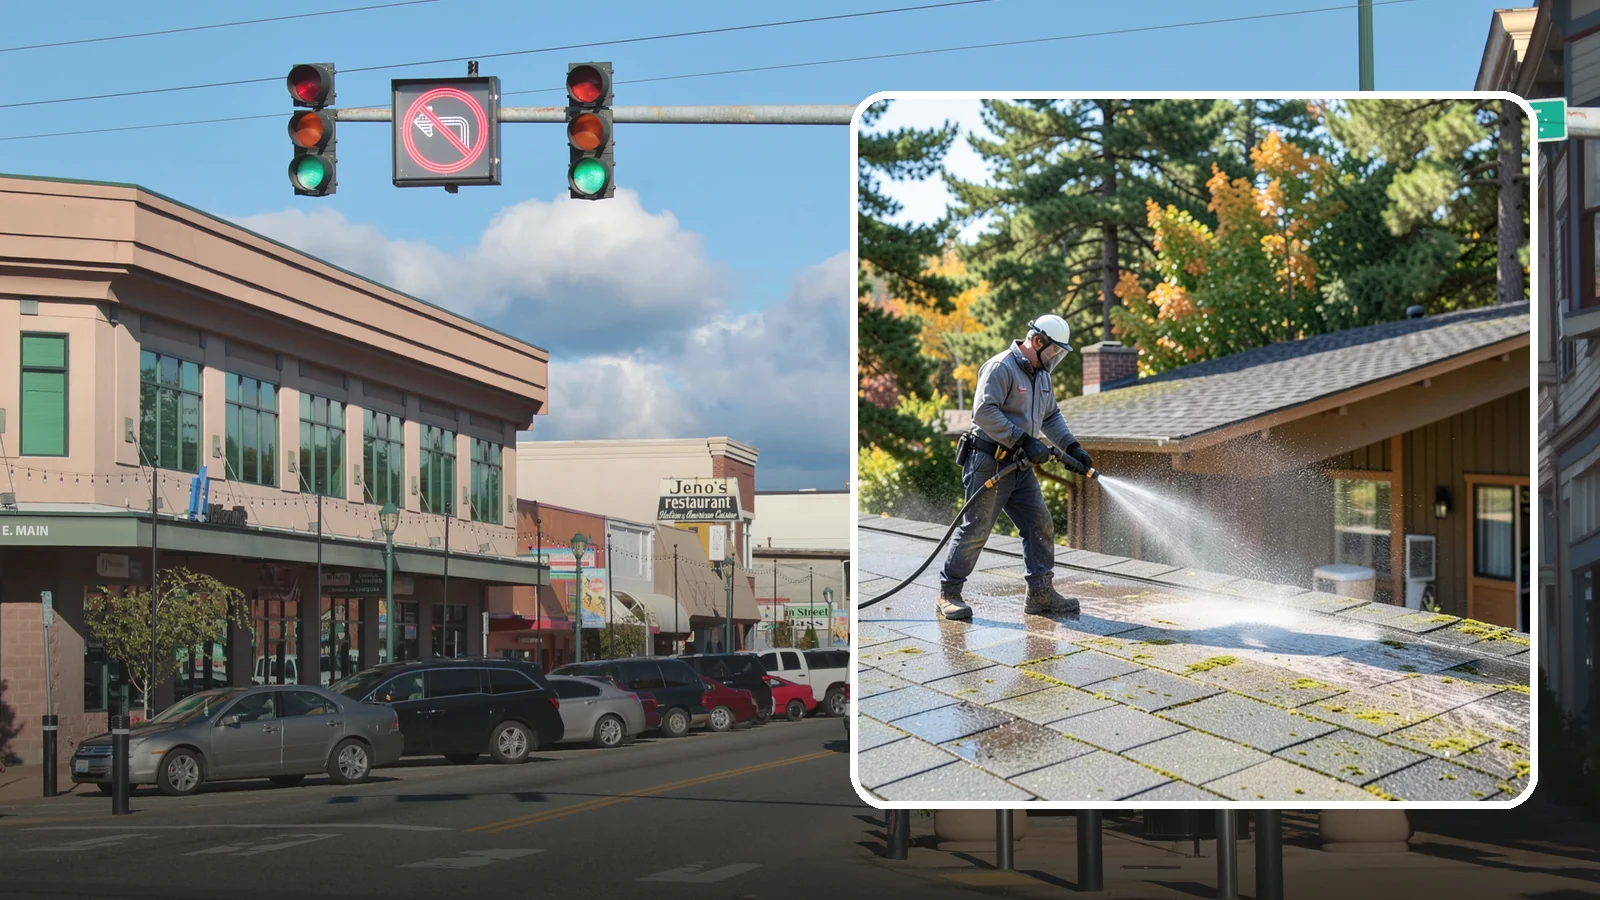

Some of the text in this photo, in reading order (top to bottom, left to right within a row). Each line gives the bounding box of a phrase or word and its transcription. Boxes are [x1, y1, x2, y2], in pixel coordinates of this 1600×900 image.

[670, 480, 727, 494] Jeno's
[665, 497, 731, 509] restaurant
[658, 510, 682, 519] Italian
[686, 509, 714, 519] American
[714, 509, 738, 519] Cuisine
[2, 525, 49, 536] E. MAIN
[797, 608, 828, 616] Street
